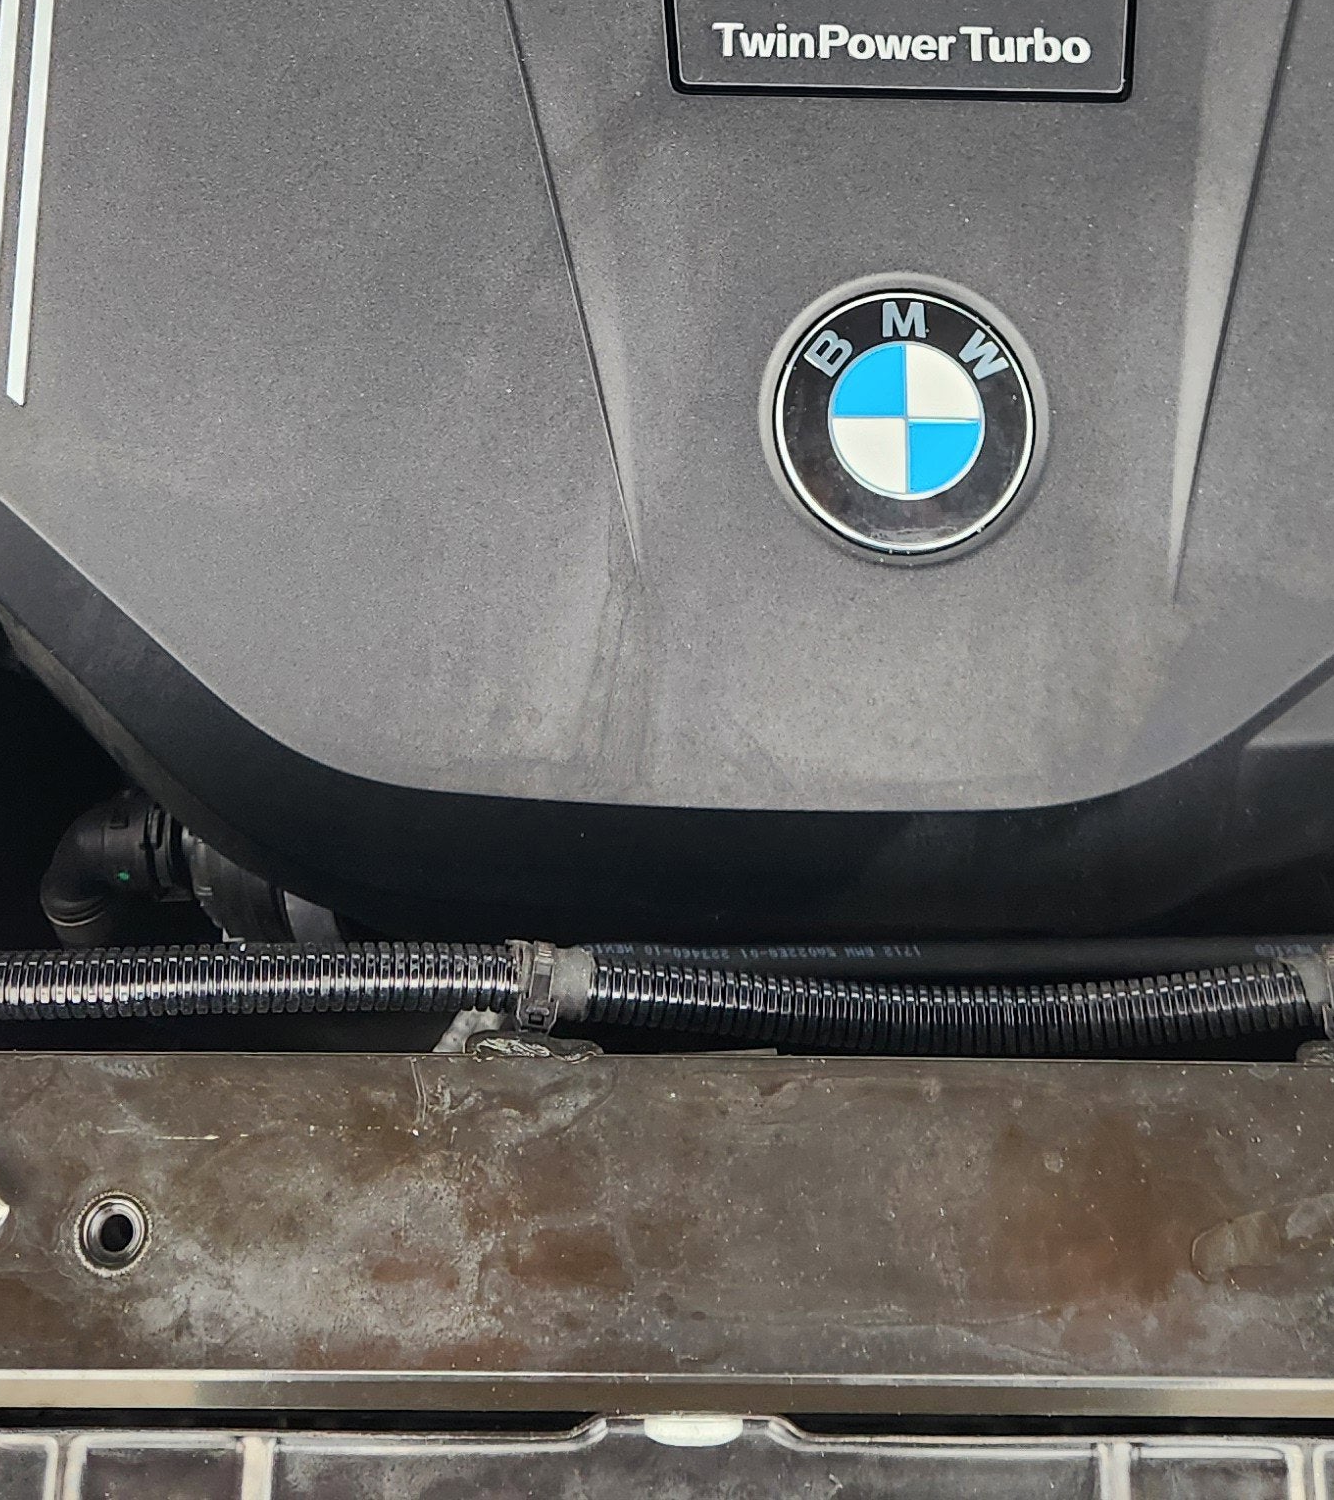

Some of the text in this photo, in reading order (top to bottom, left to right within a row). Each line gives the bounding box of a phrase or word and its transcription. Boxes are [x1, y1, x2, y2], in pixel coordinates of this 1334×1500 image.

[712, 21, 1092, 64] TwinPower Turbo
[803, 301, 1010, 380] BMW
[583, 943, 635, 955] MEXIC
